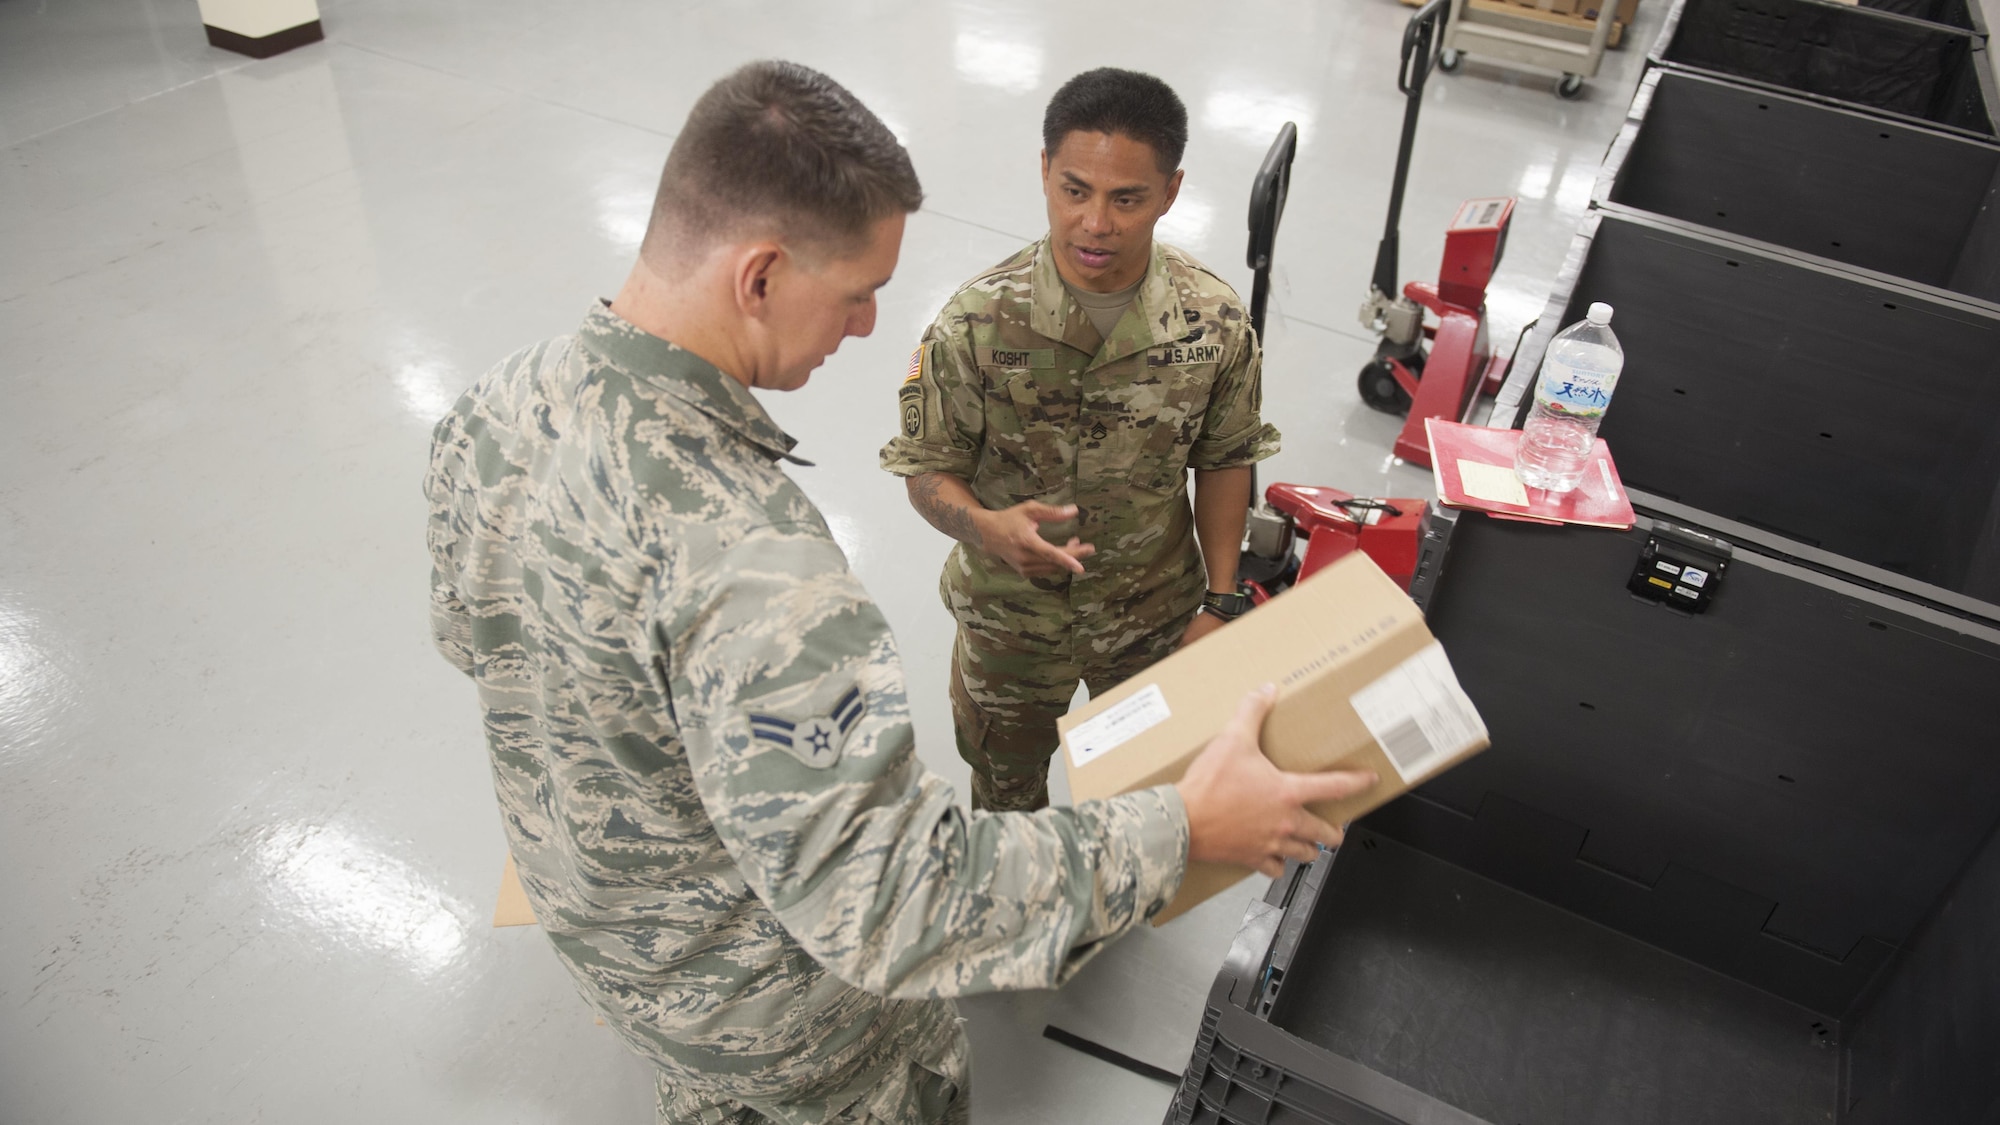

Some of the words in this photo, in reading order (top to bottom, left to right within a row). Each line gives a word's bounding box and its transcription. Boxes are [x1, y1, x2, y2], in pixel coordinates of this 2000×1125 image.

[991, 348, 1030, 366] KOSHT
[1556, 381, 1606, 403] 天然水
